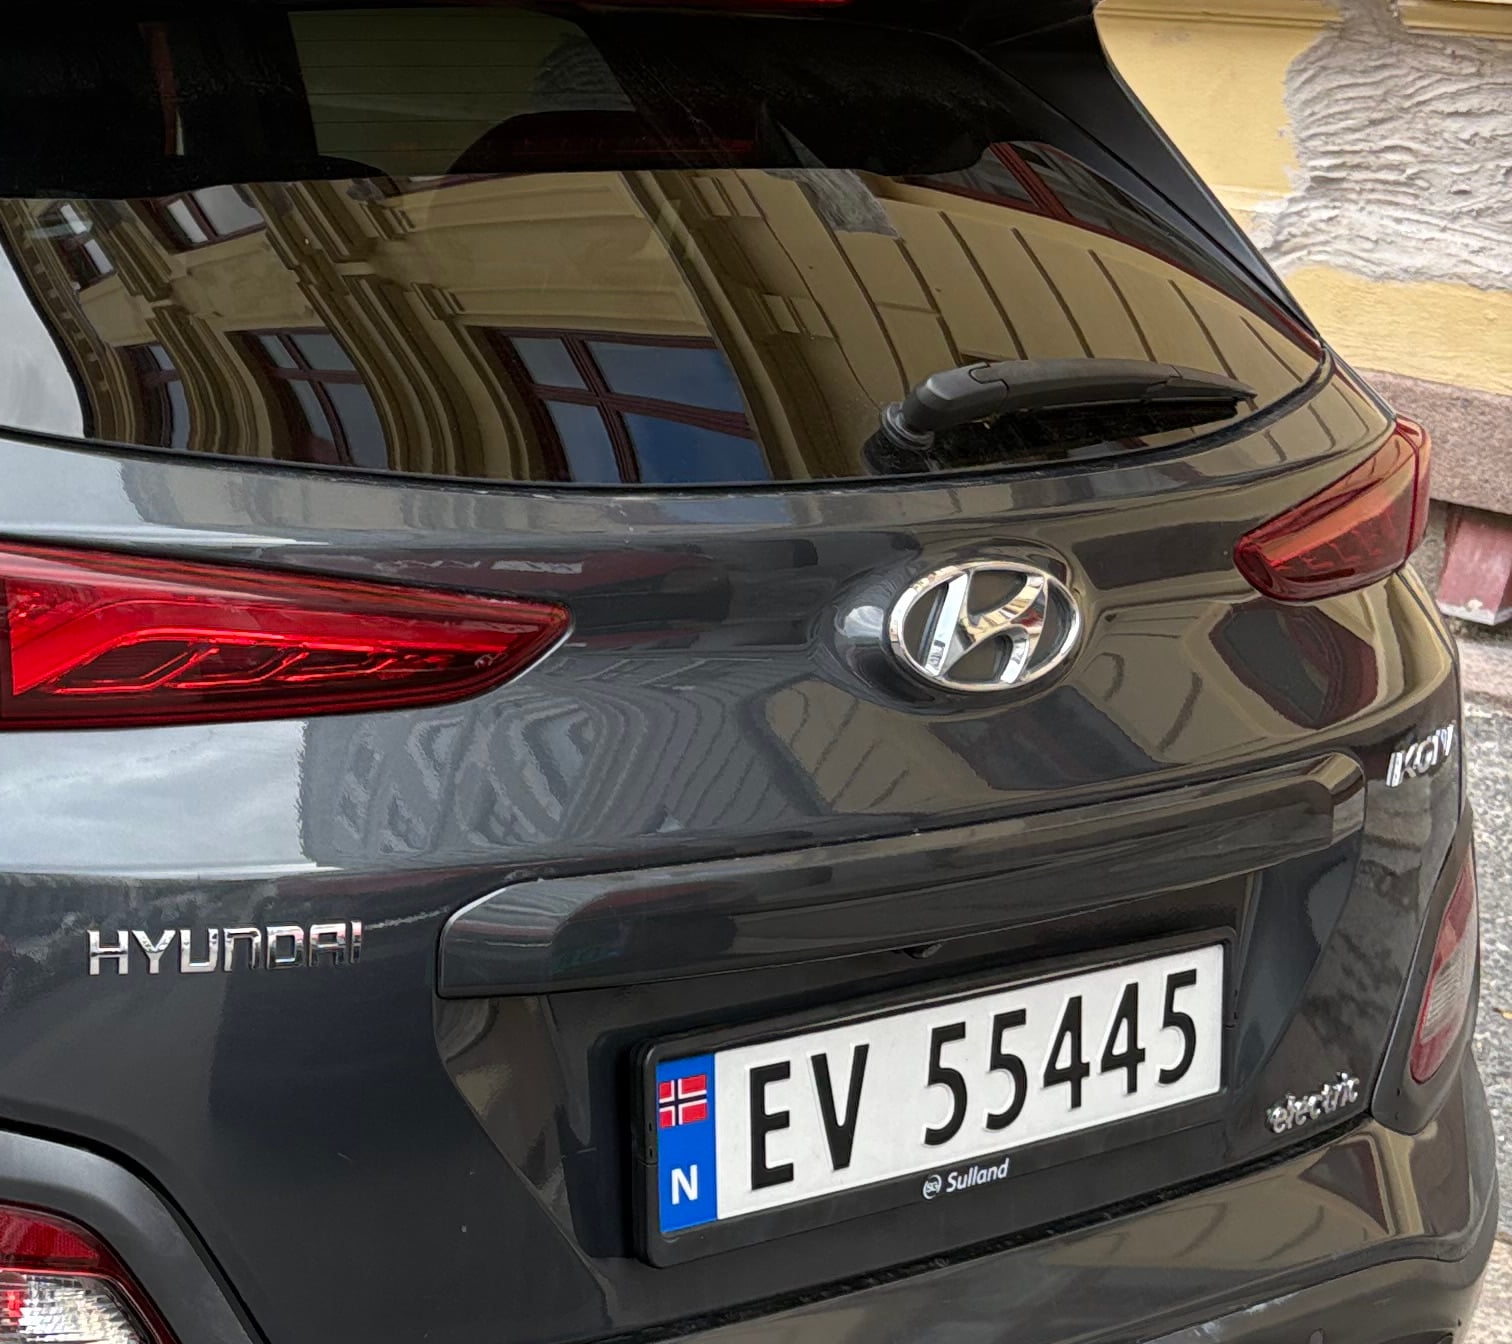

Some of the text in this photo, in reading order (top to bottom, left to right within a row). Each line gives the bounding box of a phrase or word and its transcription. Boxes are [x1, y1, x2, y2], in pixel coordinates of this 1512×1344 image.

[1385, 720, 1456, 788] KON
[87, 919, 364, 976] HYUNDAI
[748, 968, 1198, 1192] EV 55445
[1266, 1071, 1360, 1134] electric
[670, 1164, 699, 1206] N
[946, 1157, 1010, 1193] Sulland
